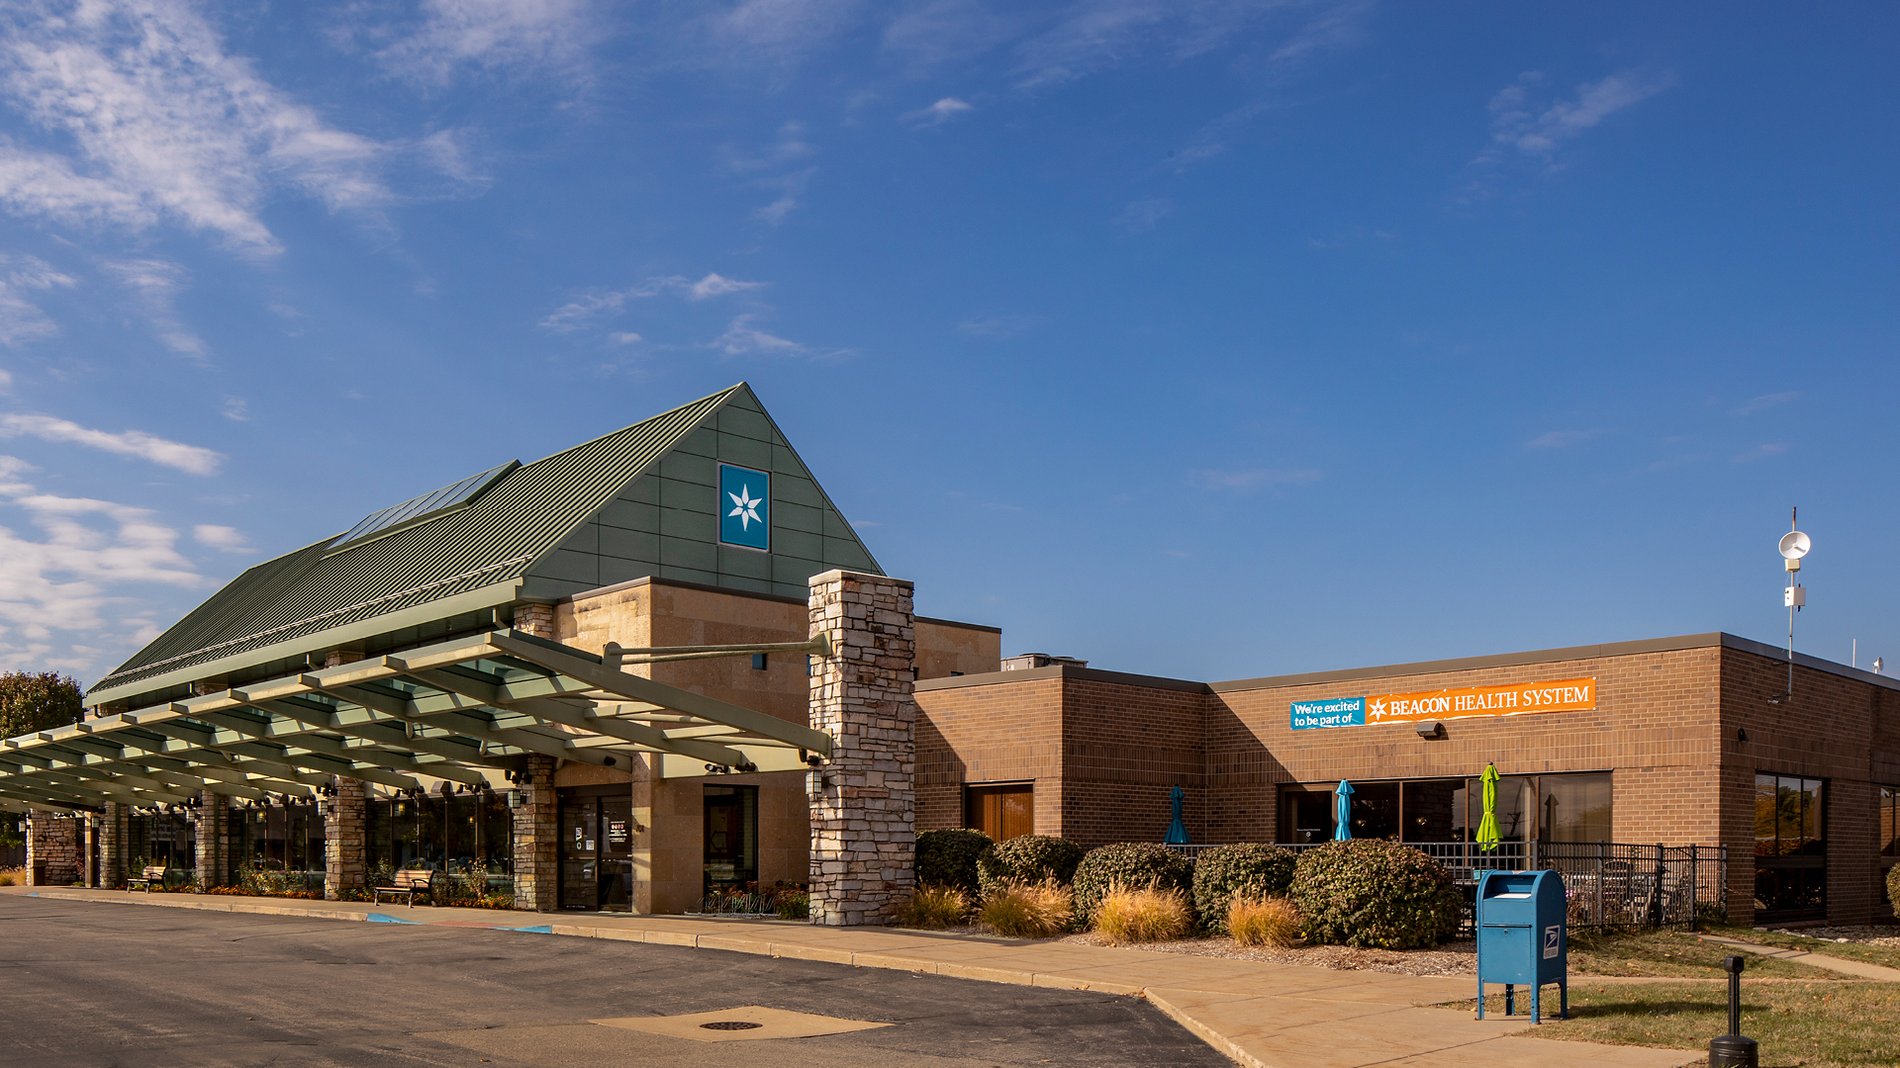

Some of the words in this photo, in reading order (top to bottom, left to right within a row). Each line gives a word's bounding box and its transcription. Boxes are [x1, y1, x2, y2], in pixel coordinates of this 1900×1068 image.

[1390, 697, 1451, 716] BEACON
[1454, 691, 1518, 711] HEALTH
[1523, 685, 1590, 706] SYSTEM
[1294, 704, 1323, 715] We're
[1324, 701, 1360, 713] excited
[1294, 716, 1305, 726] to
[1306, 715, 1319, 725] be
[1320, 714, 1340, 727] part
[1341, 713, 1353, 723] of
